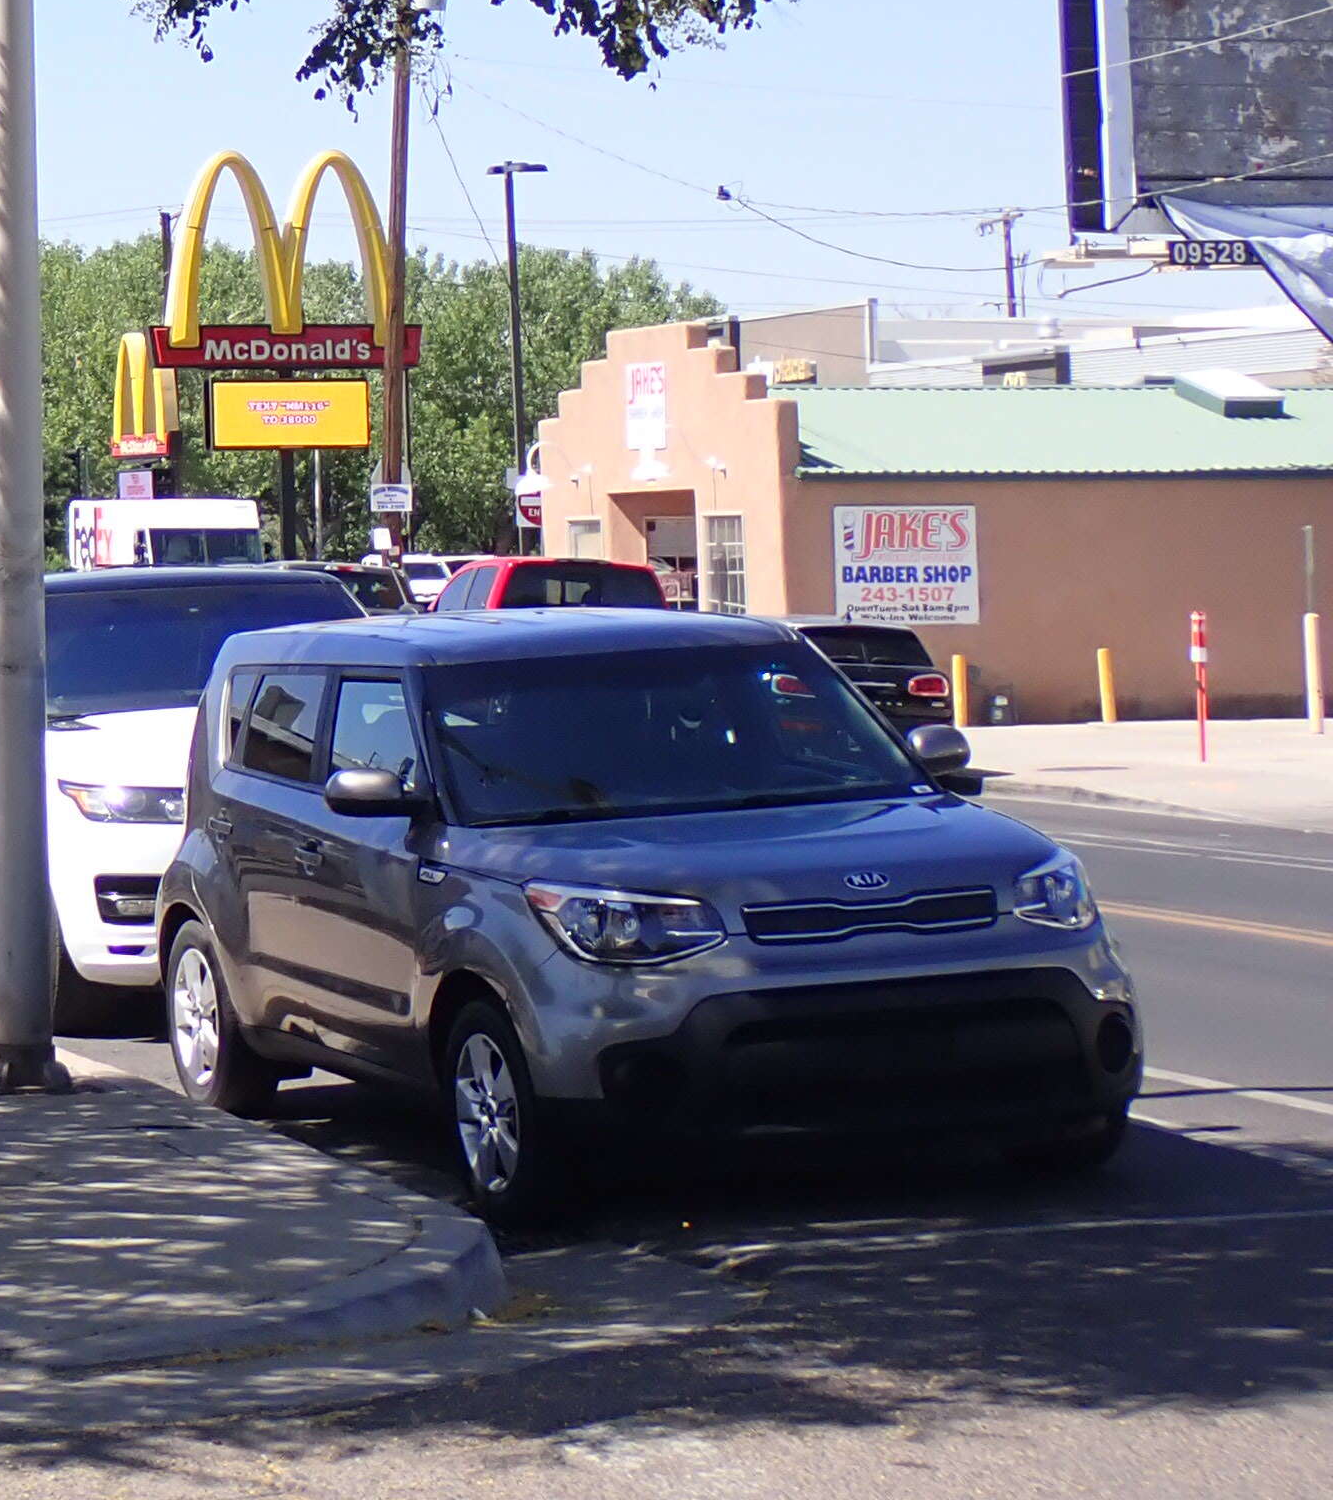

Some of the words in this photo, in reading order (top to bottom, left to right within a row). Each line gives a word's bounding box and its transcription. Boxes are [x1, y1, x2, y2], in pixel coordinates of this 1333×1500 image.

[203, 338, 372, 362] McDonald's
[247, 401, 278, 412] TEXT
[261, 414, 278, 424] TO
[853, 511, 969, 561] JAKE'S
[842, 566, 919, 583] BARBER
[923, 566, 972, 583] SHOP
[861, 587, 955, 602] 243-1507
[850, 873, 886, 886] KIA
